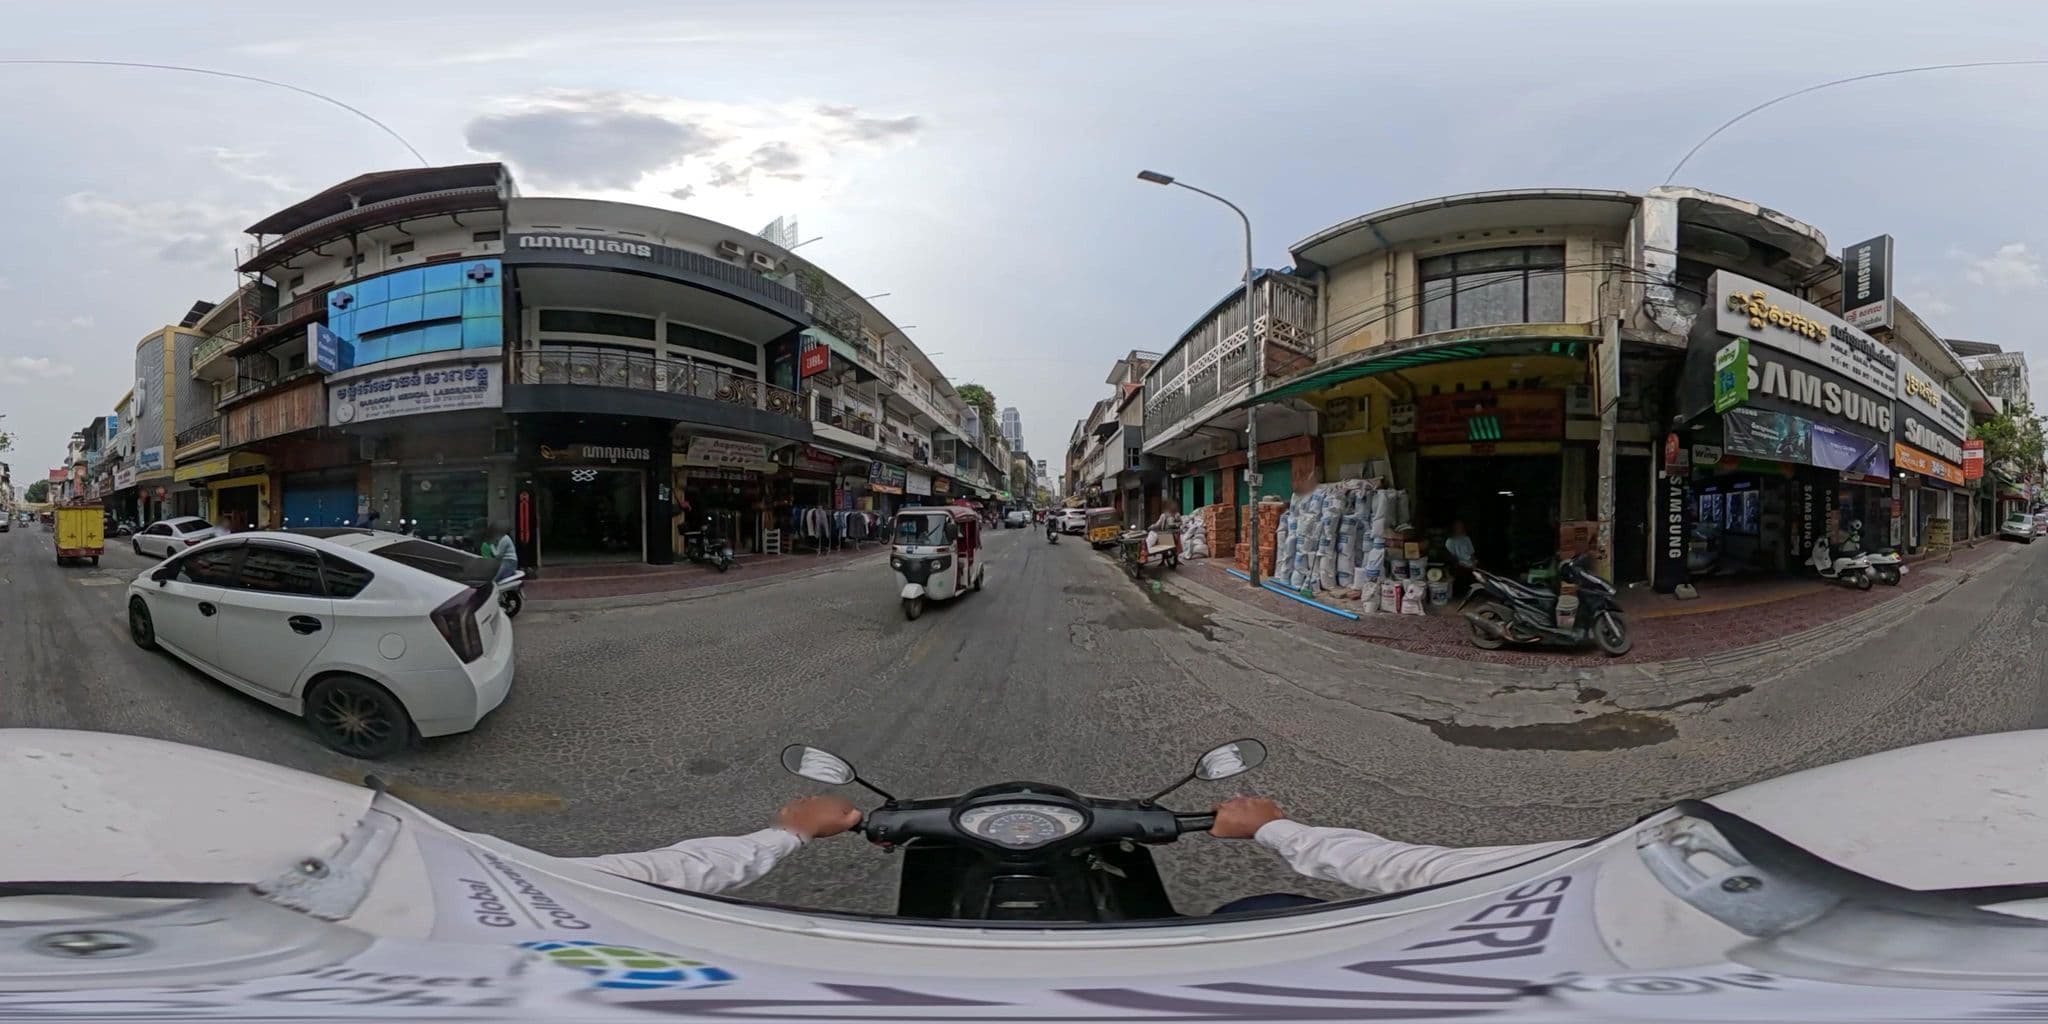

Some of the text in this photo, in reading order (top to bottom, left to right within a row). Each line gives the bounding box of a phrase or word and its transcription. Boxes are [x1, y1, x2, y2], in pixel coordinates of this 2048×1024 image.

[1857, 245, 1871, 300] SAMSUNG
[1668, 475, 1683, 560] SAMSUNG
[458, 878, 517, 928] Global
